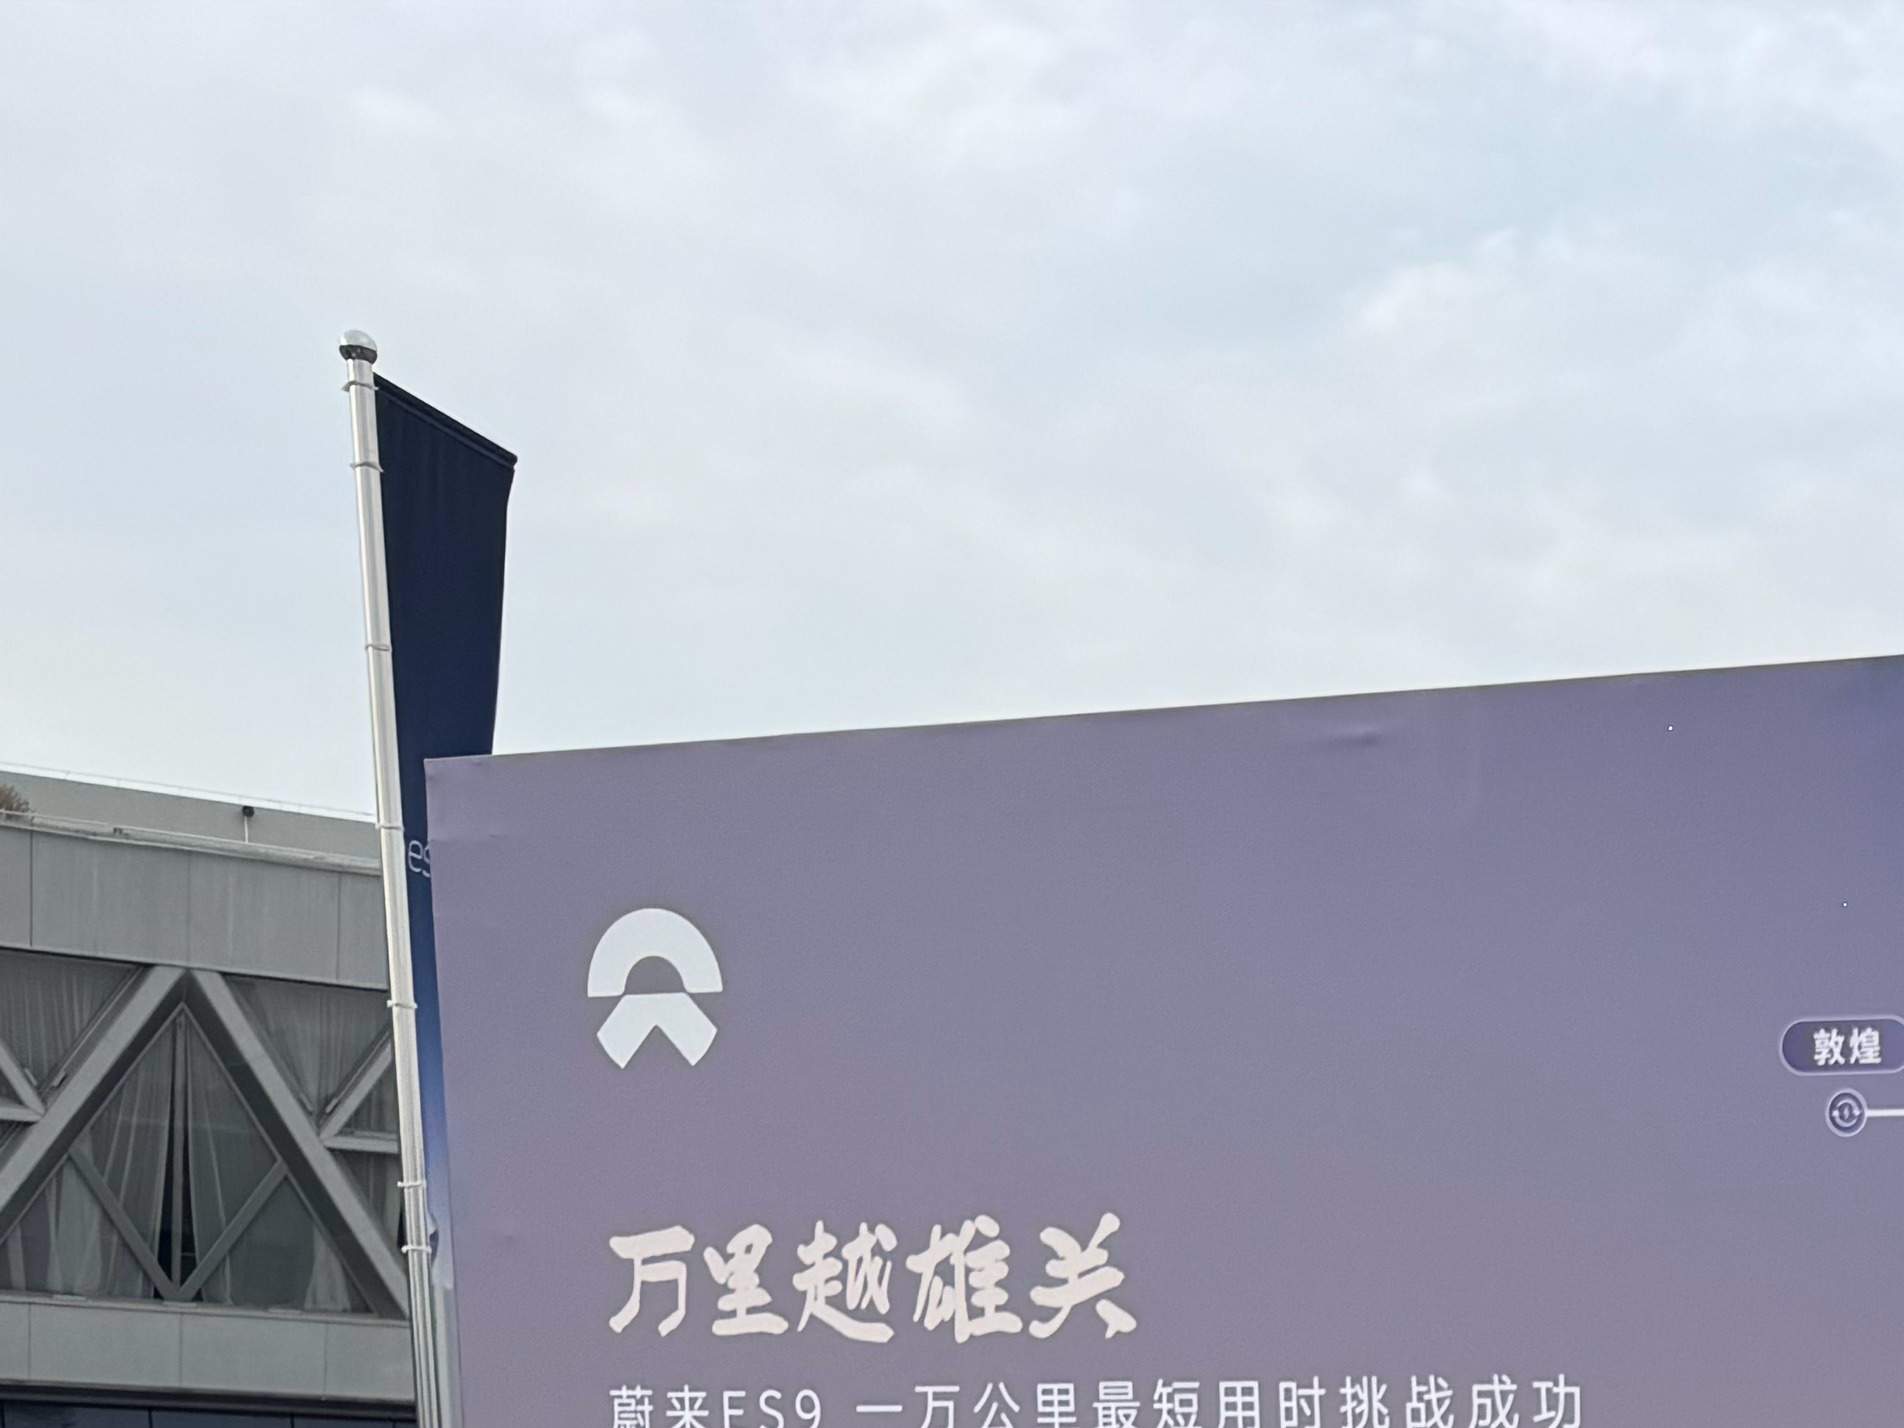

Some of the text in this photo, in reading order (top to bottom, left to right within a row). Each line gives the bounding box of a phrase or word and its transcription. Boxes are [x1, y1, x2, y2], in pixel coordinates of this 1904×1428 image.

[1814, 1028, 1881, 1065] 敦煌
[609, 1213, 1136, 1343] 万里越雄关
